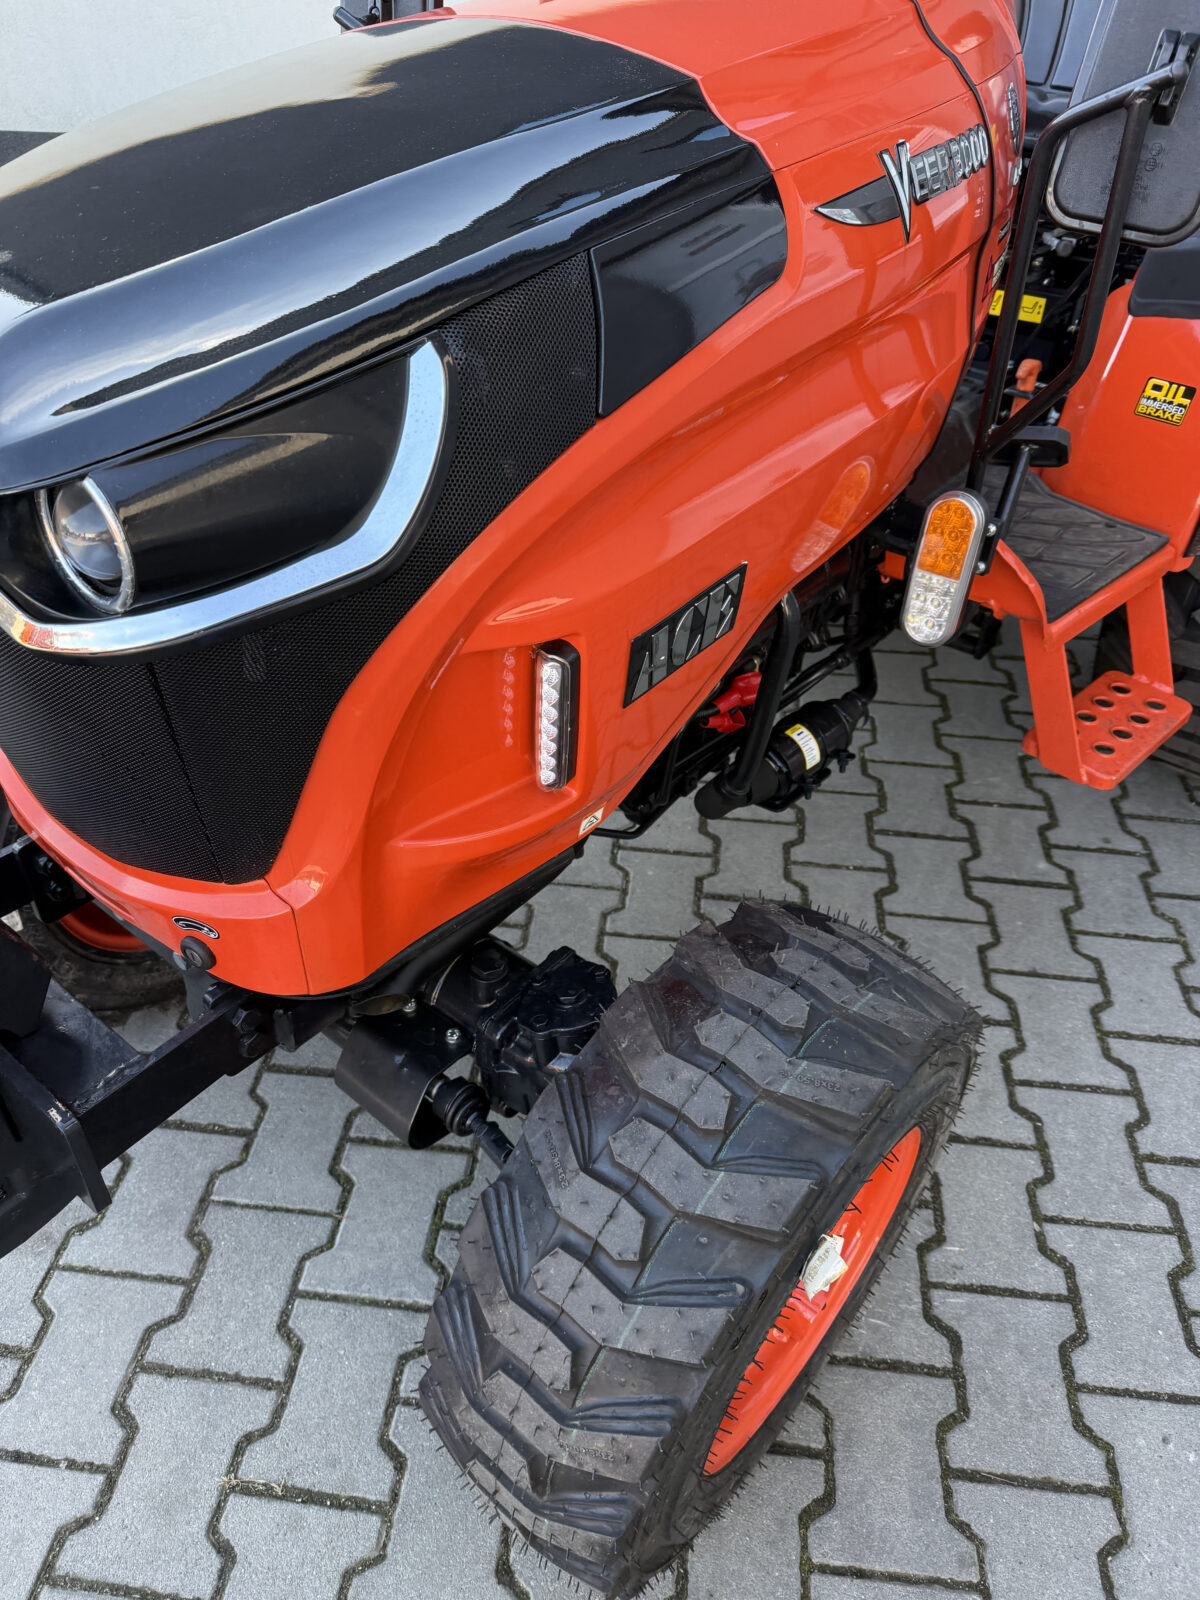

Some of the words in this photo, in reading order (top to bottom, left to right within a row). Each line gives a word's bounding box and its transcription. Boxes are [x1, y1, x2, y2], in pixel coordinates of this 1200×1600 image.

[1144, 378, 1191, 406] OIL
[1137, 404, 1183, 422] BRAKE
[1140, 397, 1185, 415] IMMERSED
